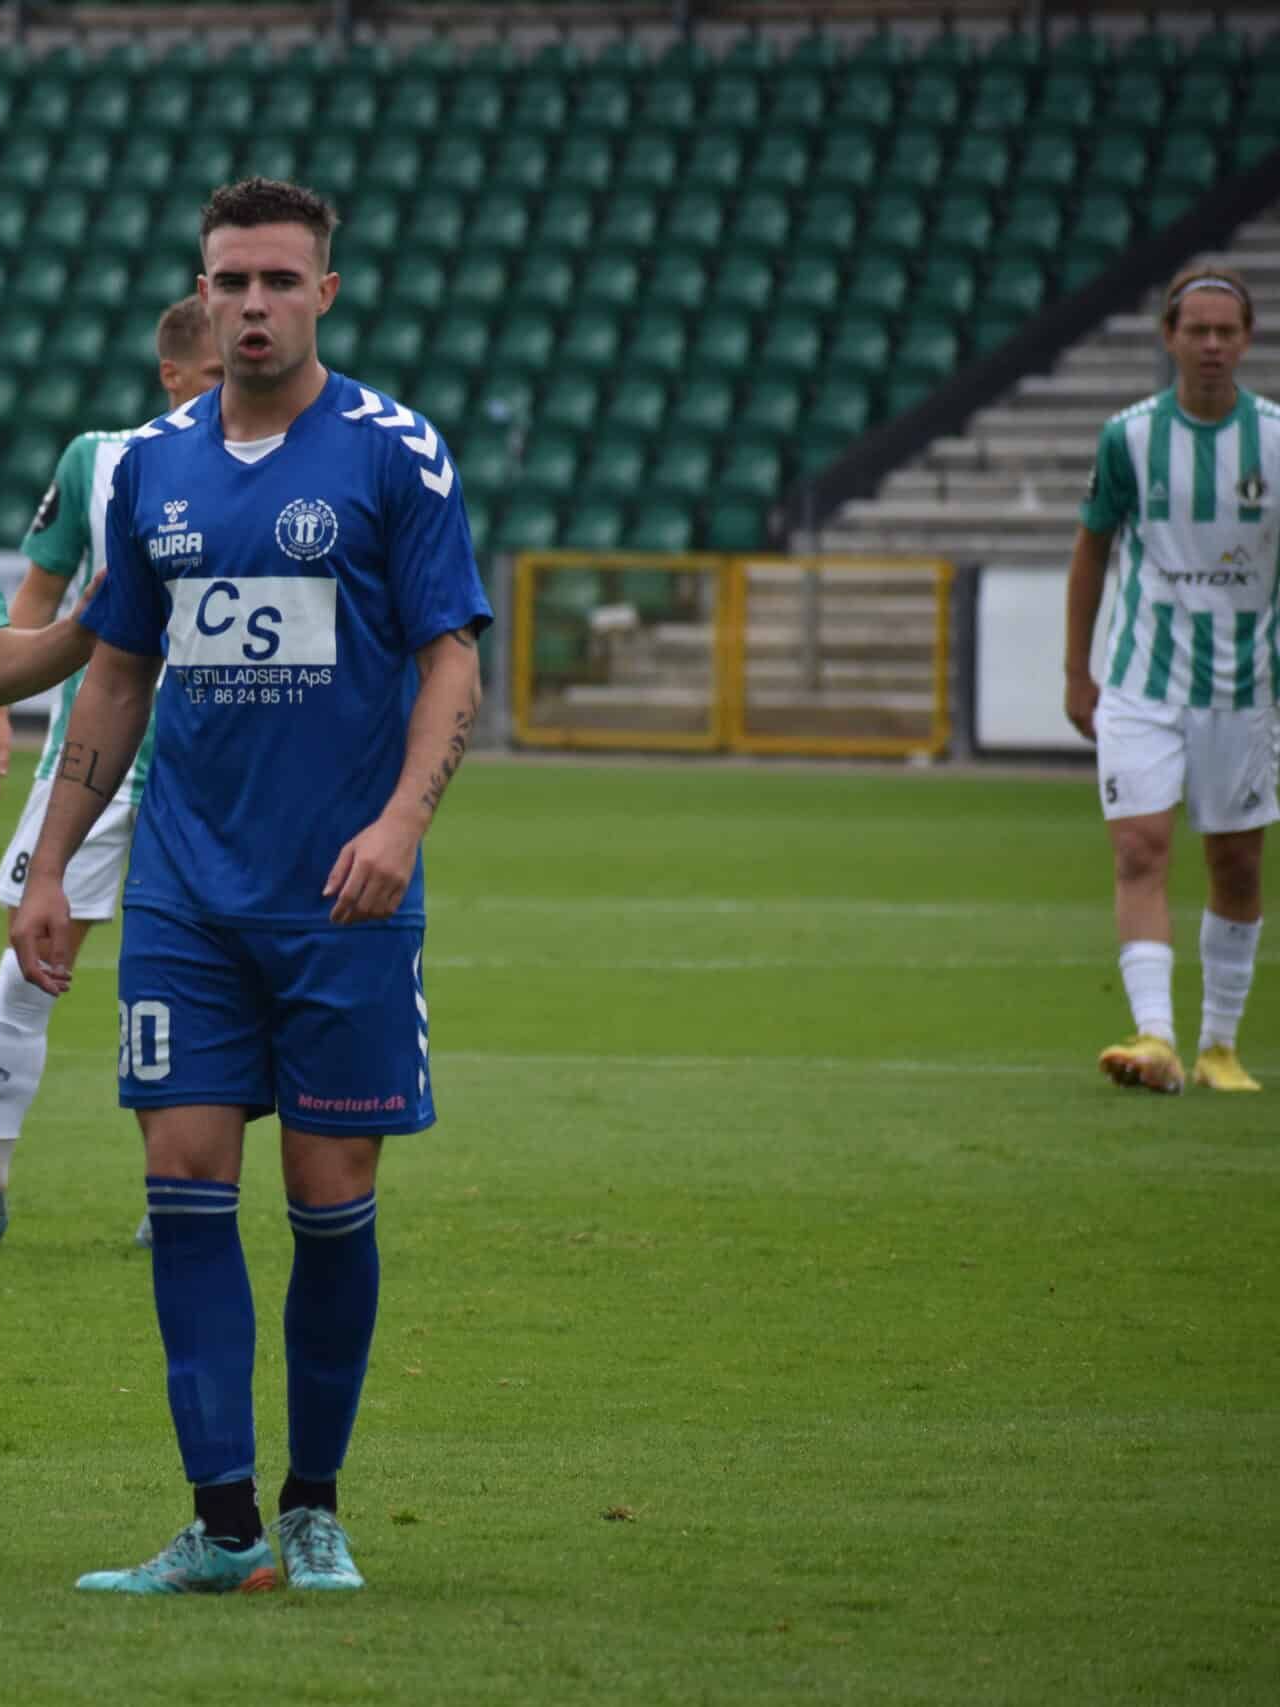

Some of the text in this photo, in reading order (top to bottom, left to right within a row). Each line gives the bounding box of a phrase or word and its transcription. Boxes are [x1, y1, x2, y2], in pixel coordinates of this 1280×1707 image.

[148, 532, 203, 560] AURA
[193, 669, 292, 685] STILLADSER
[297, 669, 332, 688] ApS
[214, 688, 233, 704] 86
[237, 688, 256, 704] 24
[261, 688, 280, 704] 95
[286, 688, 303, 704] 11
[119, 1001, 170, 1081] 0
